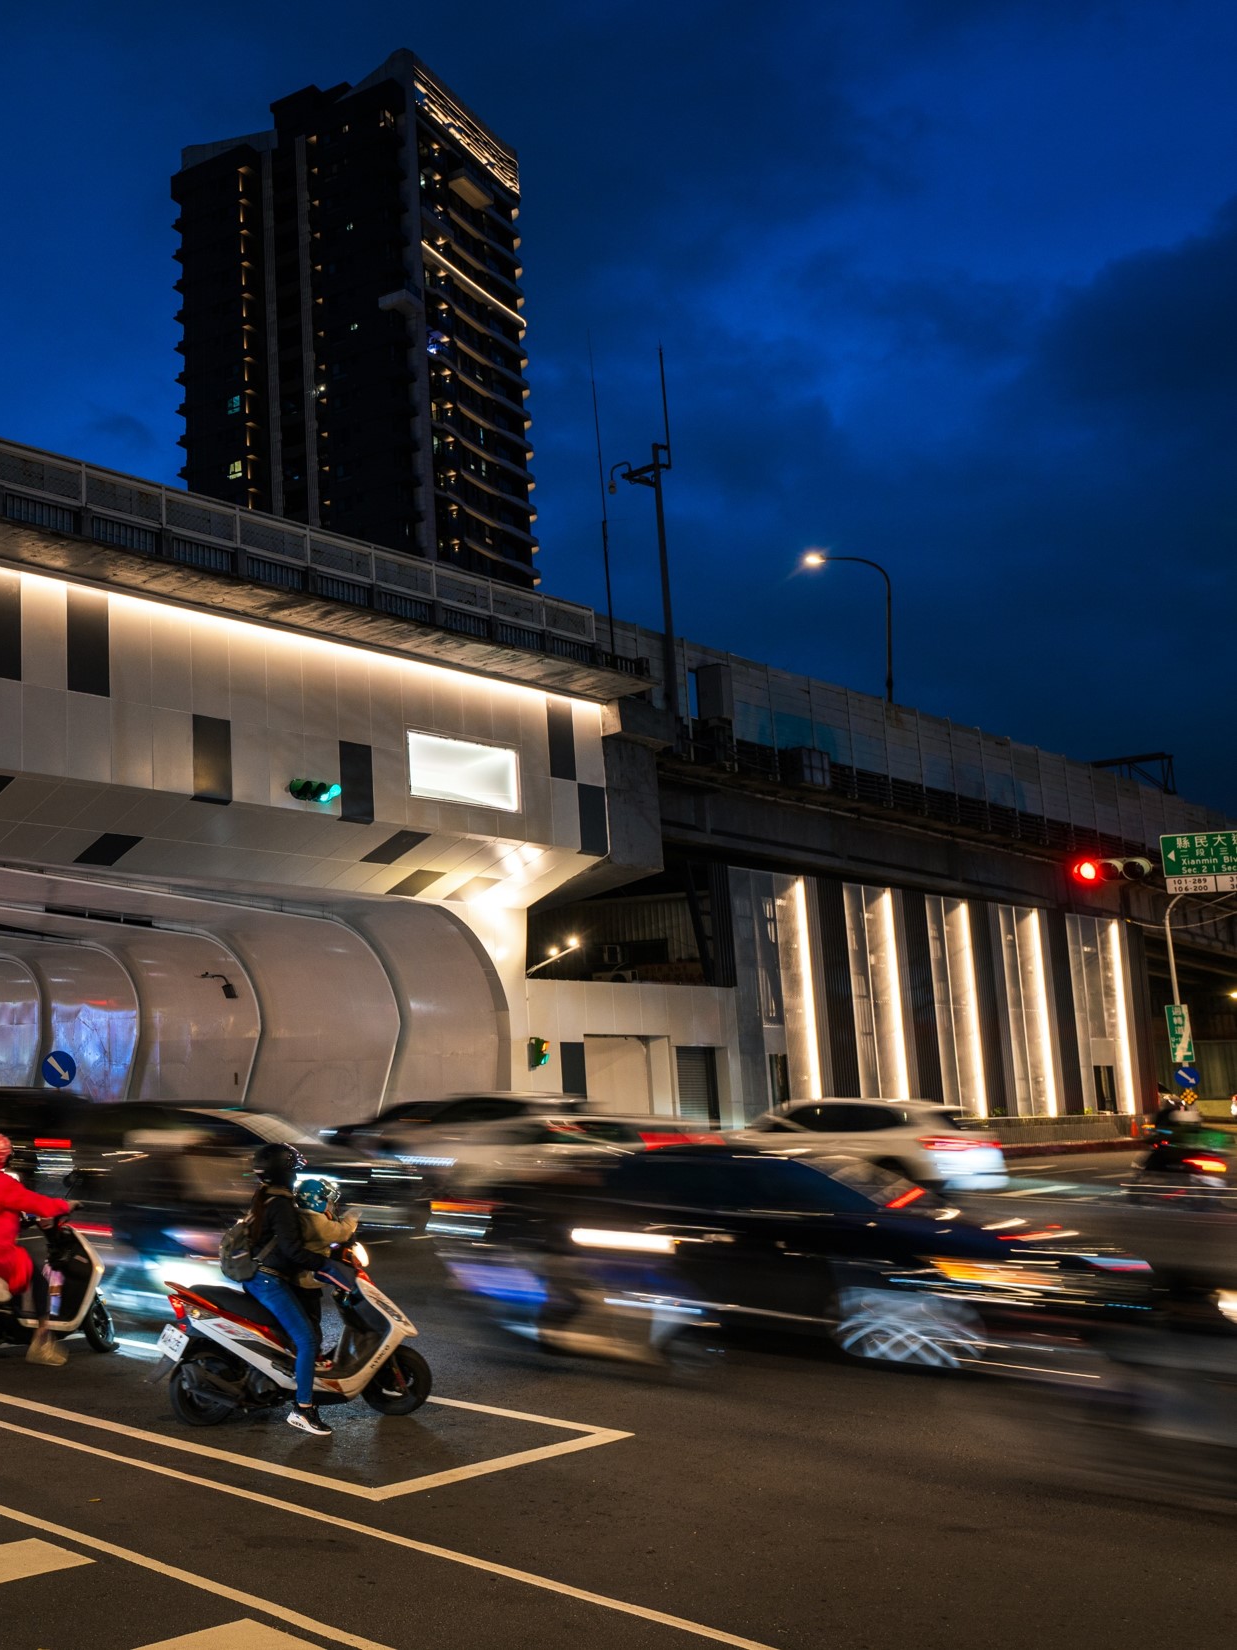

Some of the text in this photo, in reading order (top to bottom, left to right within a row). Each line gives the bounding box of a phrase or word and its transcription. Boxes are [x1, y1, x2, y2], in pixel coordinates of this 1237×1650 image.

[1181, 857, 1218, 866] Xianmin
[1202, 865, 1208, 873] 2
[1174, 885, 1208, 893] 106-200
